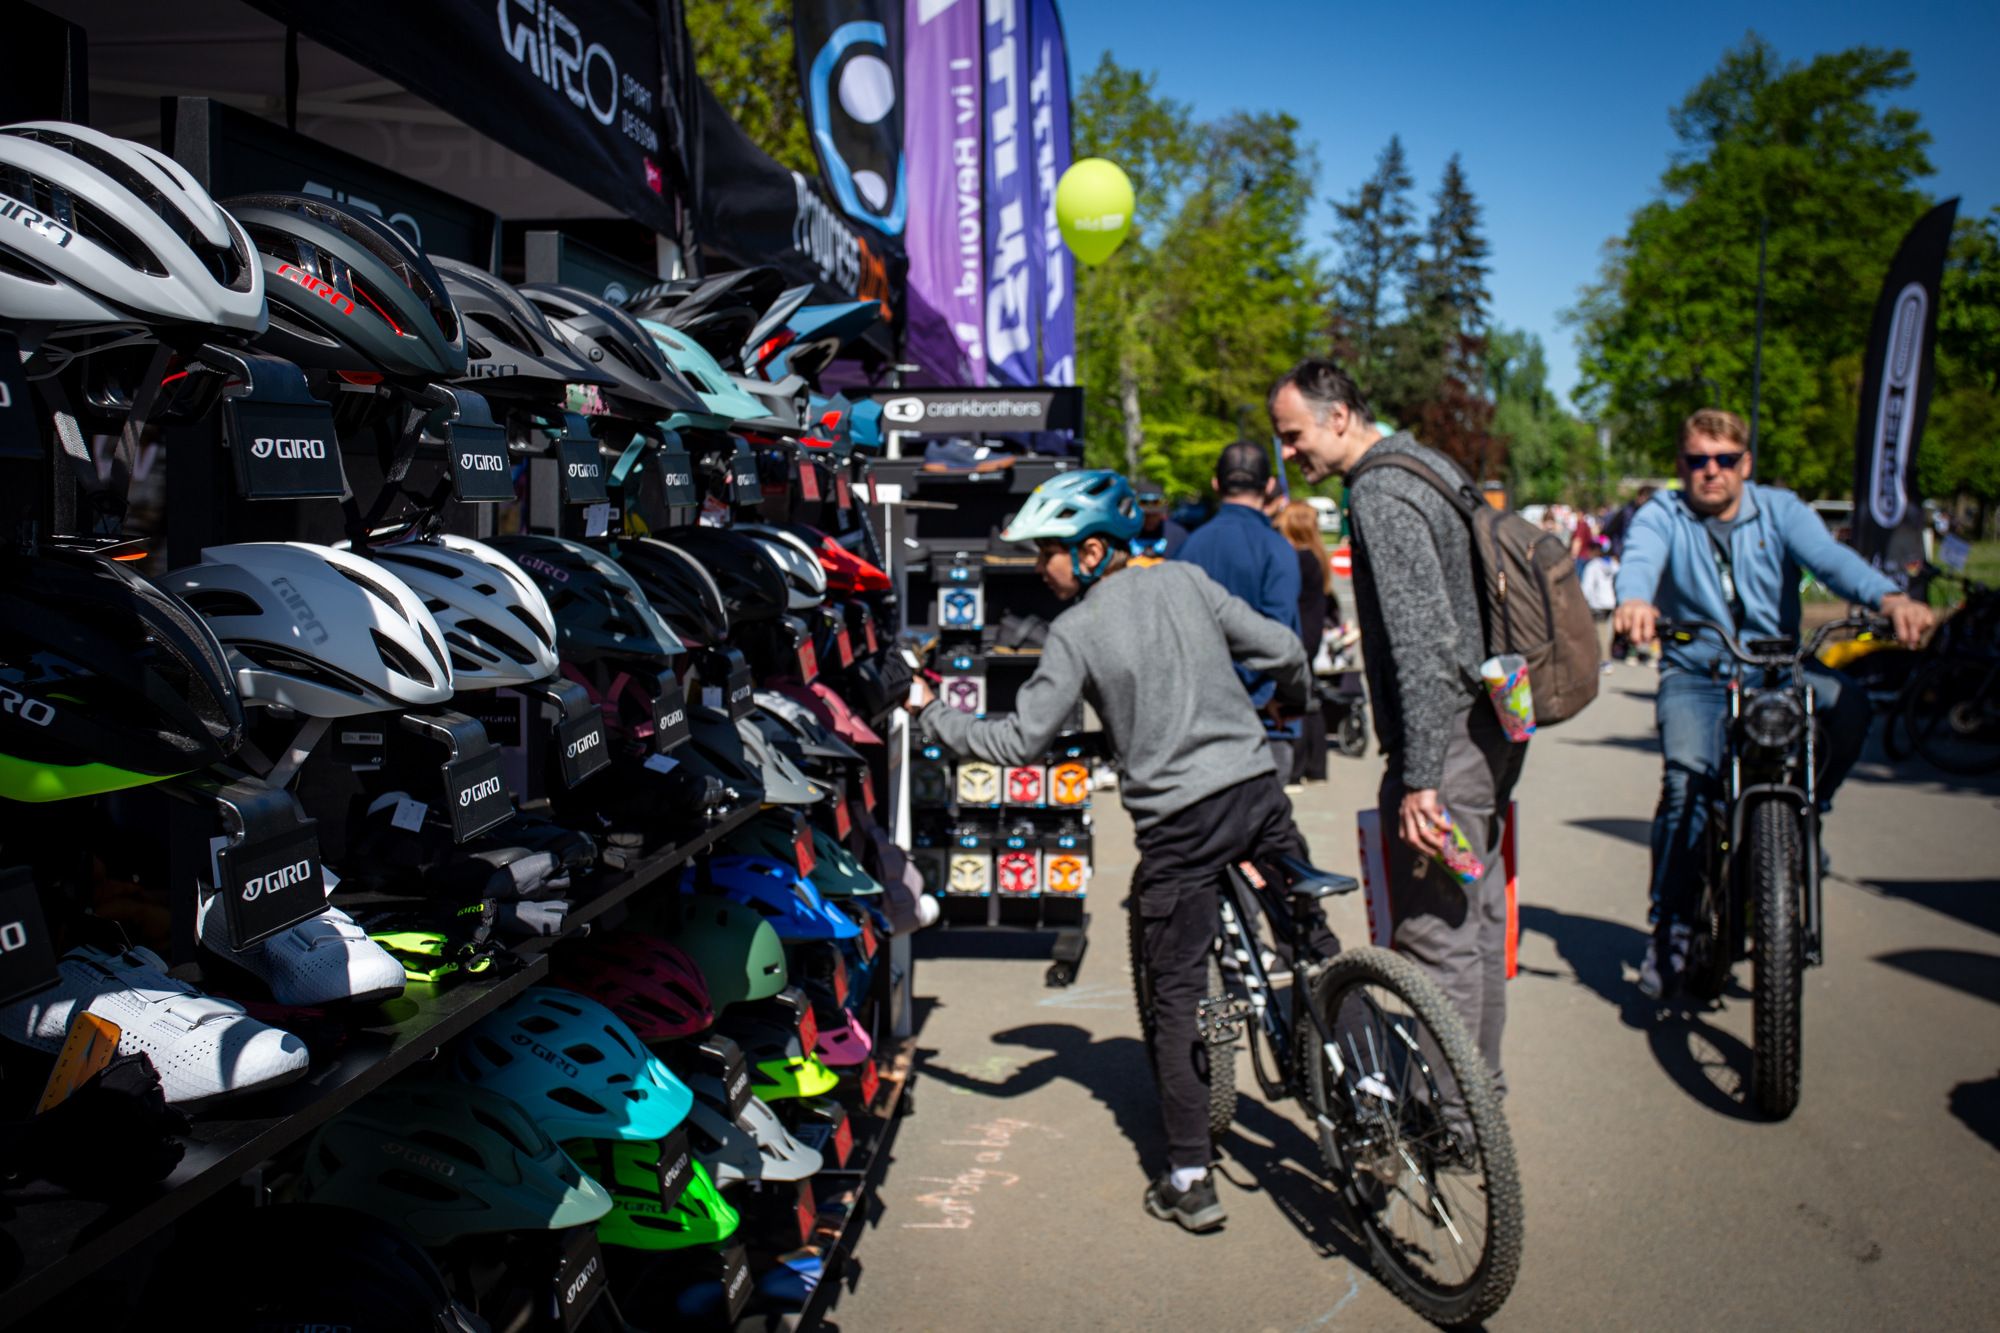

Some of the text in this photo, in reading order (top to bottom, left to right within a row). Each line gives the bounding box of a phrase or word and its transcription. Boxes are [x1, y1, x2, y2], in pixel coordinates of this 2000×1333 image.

[497, 0, 618, 125] GIRO
[622, 73, 652, 113] SPORT
[622, 109, 658, 152] DESIGN
[0, 196, 73, 248] IRO
[276, 264, 355, 316] GIRO
[926, 398, 1042, 418] crankbrothers
[276, 439, 325, 459] GIRO
[474, 454, 503, 472] GIRO
[576, 463, 598, 479] GIRO
[518, 554, 569, 583] GIRO
[271, 577, 329, 646] GIRO
[668, 709, 684, 727] GIRO
[576, 730, 600, 753] GIRO
[472, 776, 500, 802] GIRO
[264, 859, 311, 895] GIRO
[457, 903, 485, 917] GIRO
[531, 1043, 579, 1079] GIRO
[403, 1148, 456, 1177] GIRO
[575, 1257, 598, 1293] GIRO
